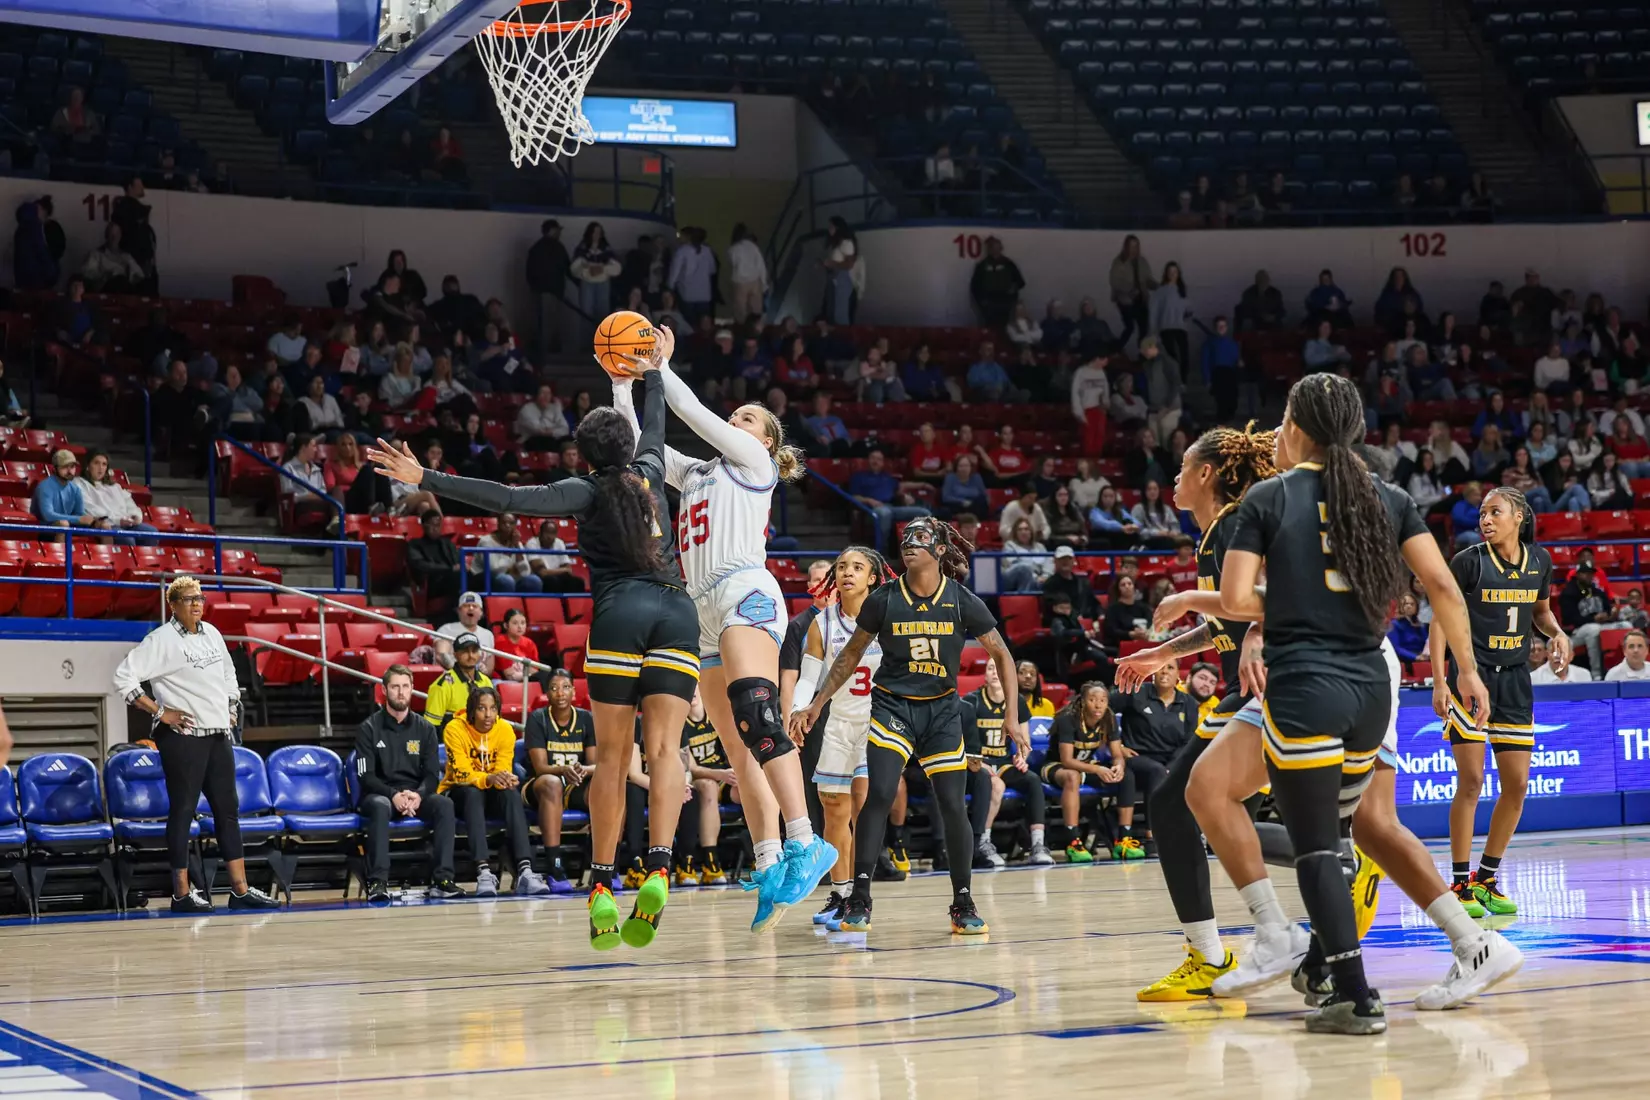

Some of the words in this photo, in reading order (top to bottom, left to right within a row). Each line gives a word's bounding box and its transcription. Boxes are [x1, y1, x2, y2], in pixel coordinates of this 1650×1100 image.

[83, 193, 119, 221] 11
[953, 234, 983, 259] 10
[1399, 232, 1447, 257] 102
[680, 499, 710, 553] 25
[1506, 606, 1519, 633] 1
[909, 637, 939, 662] 21
